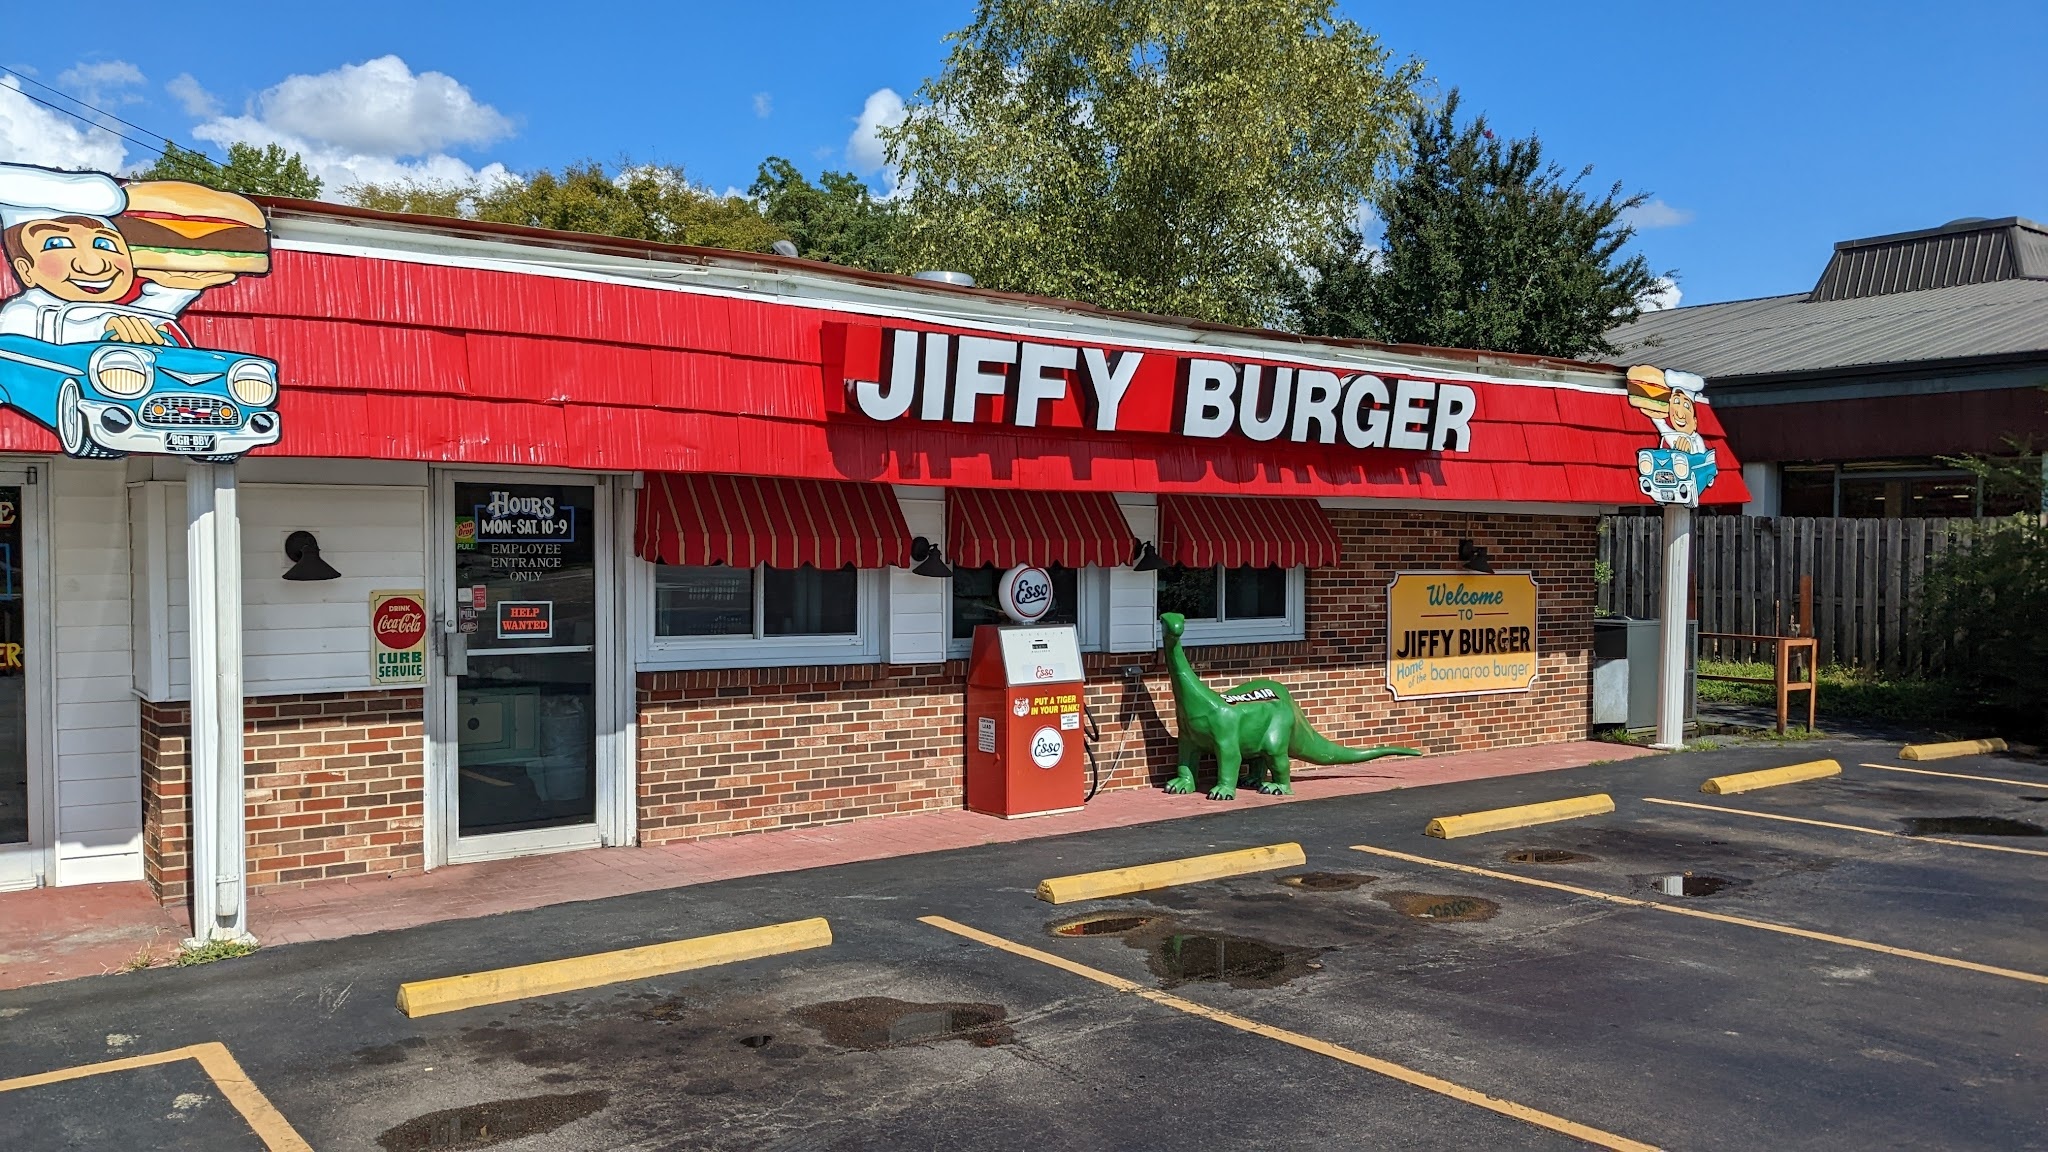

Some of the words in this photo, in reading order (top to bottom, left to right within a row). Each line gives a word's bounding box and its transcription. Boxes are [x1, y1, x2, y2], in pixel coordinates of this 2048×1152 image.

[856, 329, 1145, 431] JIFFY
[1182, 358, 1476, 452] BURGER
[171, 435, 210, 446] BGR-BBY
[458, 528, 474, 537] Drop
[541, 519, 568, 535] 10-9
[491, 543, 562, 555] EMPLOYEE
[491, 557, 562, 568] ENTRANCE
[509, 571, 543, 582] ONLY
[1015, 580, 1048, 604] Esso
[1426, 583, 1504, 606] Welcome
[460, 609, 477, 619] PULL
[510, 607, 540, 618] HELP
[1458, 608, 1473, 621] TO
[502, 620, 549, 631] WANTED
[1396, 629, 1455, 658] JIFFY
[1458, 626, 1531, 656] BURGER
[378, 651, 422, 664] CURB
[378, 664, 423, 677] SERVICE
[1035, 665, 1054, 679] Esso
[1397, 659, 1424, 681] Home
[1430, 662, 1490, 681] bonnaroo
[1493, 658, 1530, 681] burger
[1408, 676, 1415, 689] of
[1416, 672, 1427, 685] the
[1034, 697, 1048, 706] PUT
[1049, 696, 1055, 705] A
[1056, 695, 1077, 704] TIGER
[1220, 688, 1276, 703] SINCLAIR
[1030, 707, 1038, 716] IN
[1039, 705, 1059, 715] YOUR
[1060, 703, 1080, 713] TANK!
[1034, 737, 1061, 757] Esso
